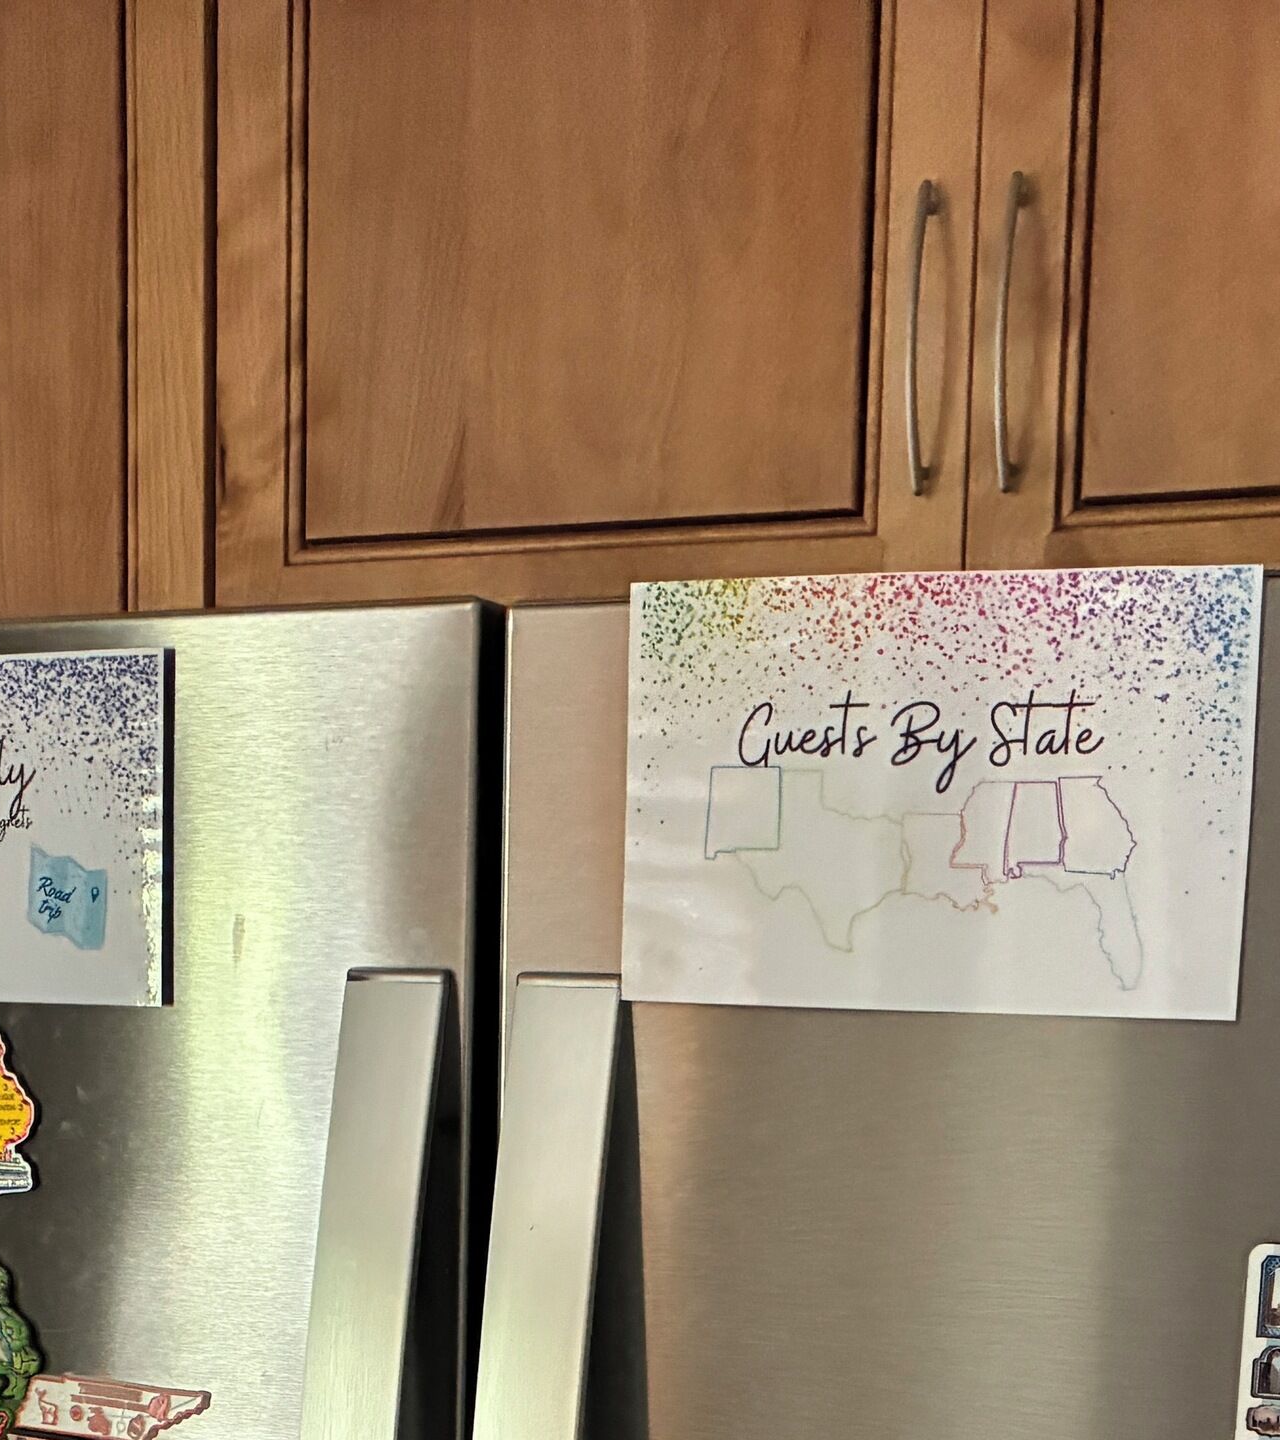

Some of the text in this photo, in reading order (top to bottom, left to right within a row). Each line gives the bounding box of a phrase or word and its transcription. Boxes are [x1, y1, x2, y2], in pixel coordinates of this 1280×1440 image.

[738, 689, 1105, 794] Guests By State
[36, 876, 77, 903] Road
[38, 898, 62, 924] trip
